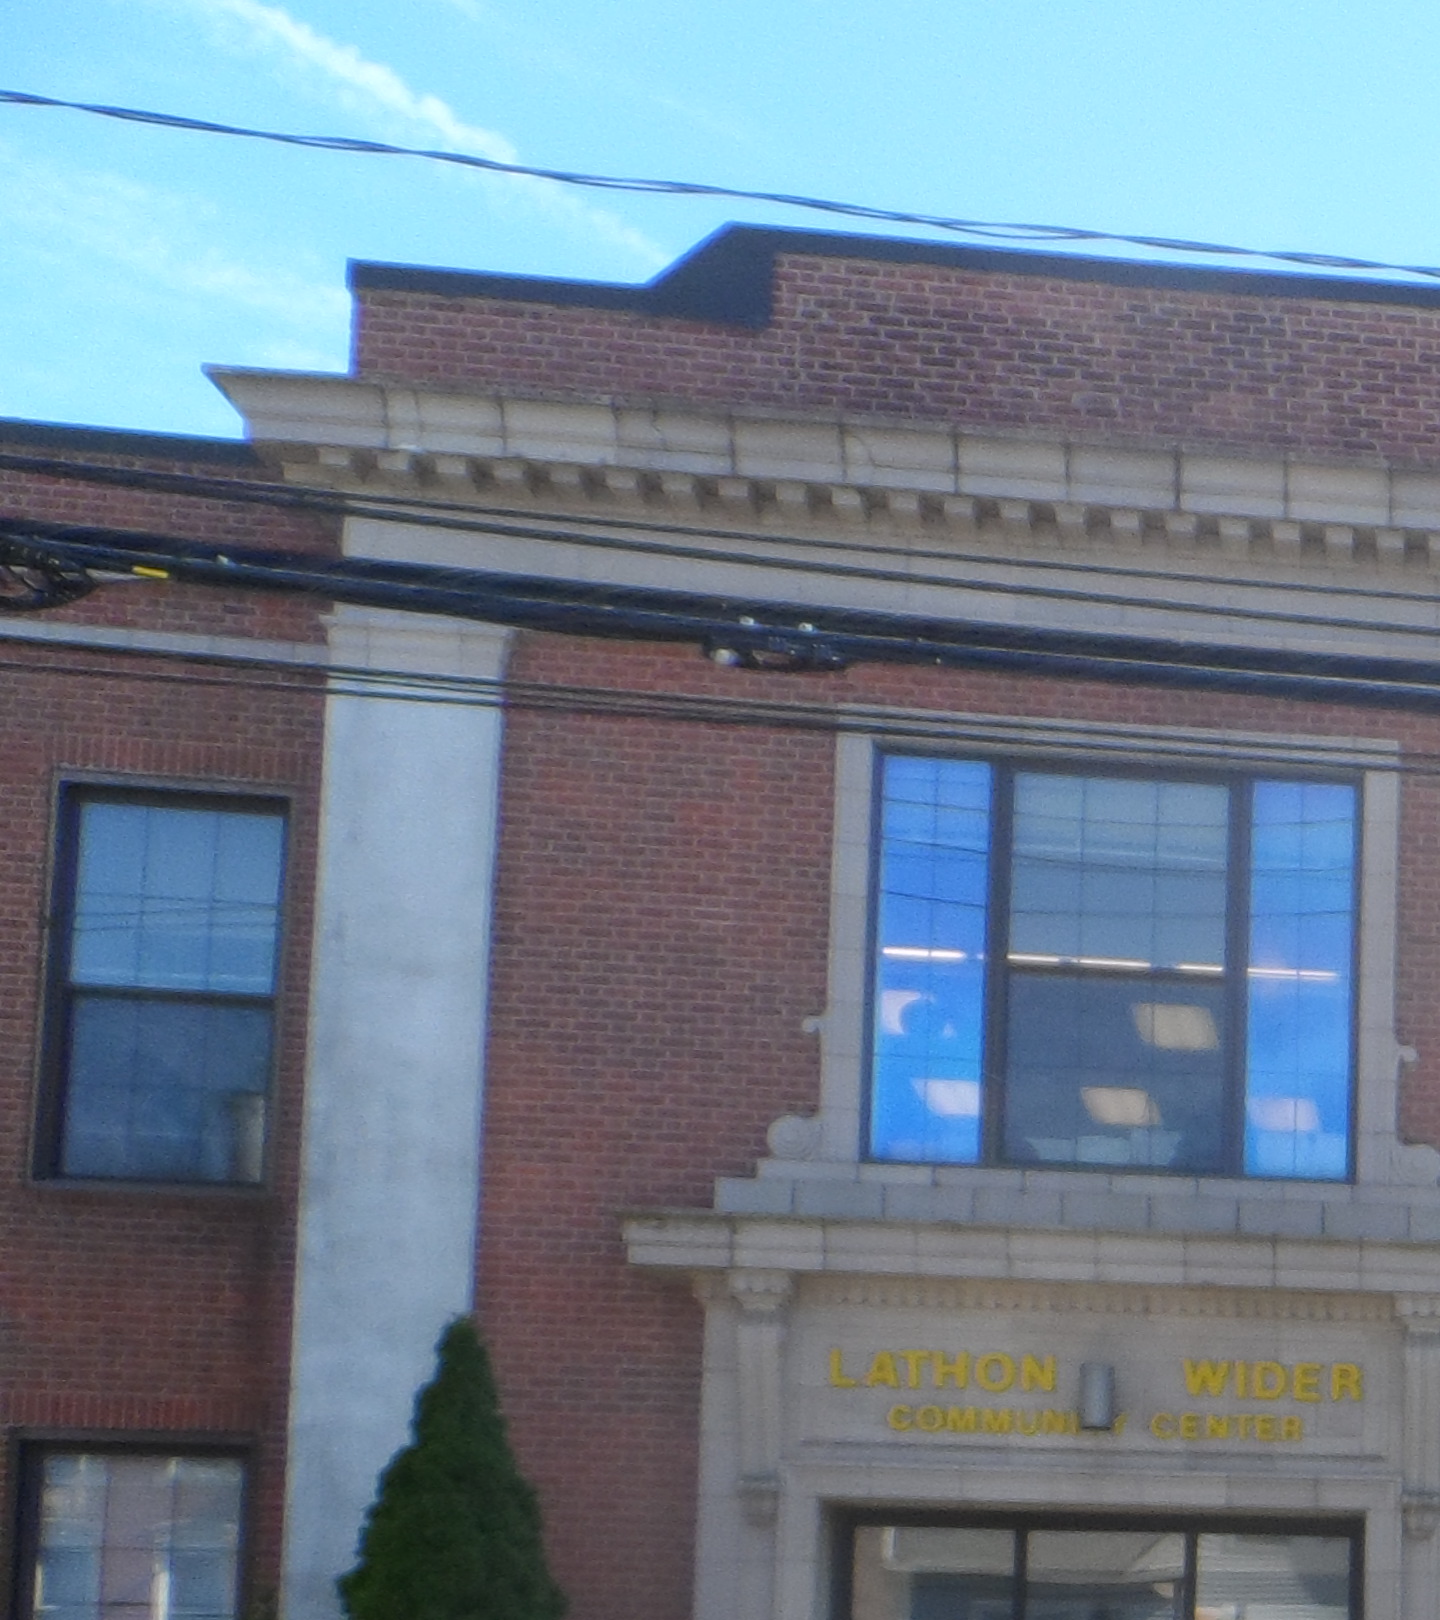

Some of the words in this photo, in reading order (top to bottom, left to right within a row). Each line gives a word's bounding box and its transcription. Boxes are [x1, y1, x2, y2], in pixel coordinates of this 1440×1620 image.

[828, 1348, 1056, 1392] LATHON
[1182, 1357, 1365, 1402] WIDER
[887, 1404, 1128, 1437] COMMUNIY
[1151, 1411, 1302, 1442] CENTER
